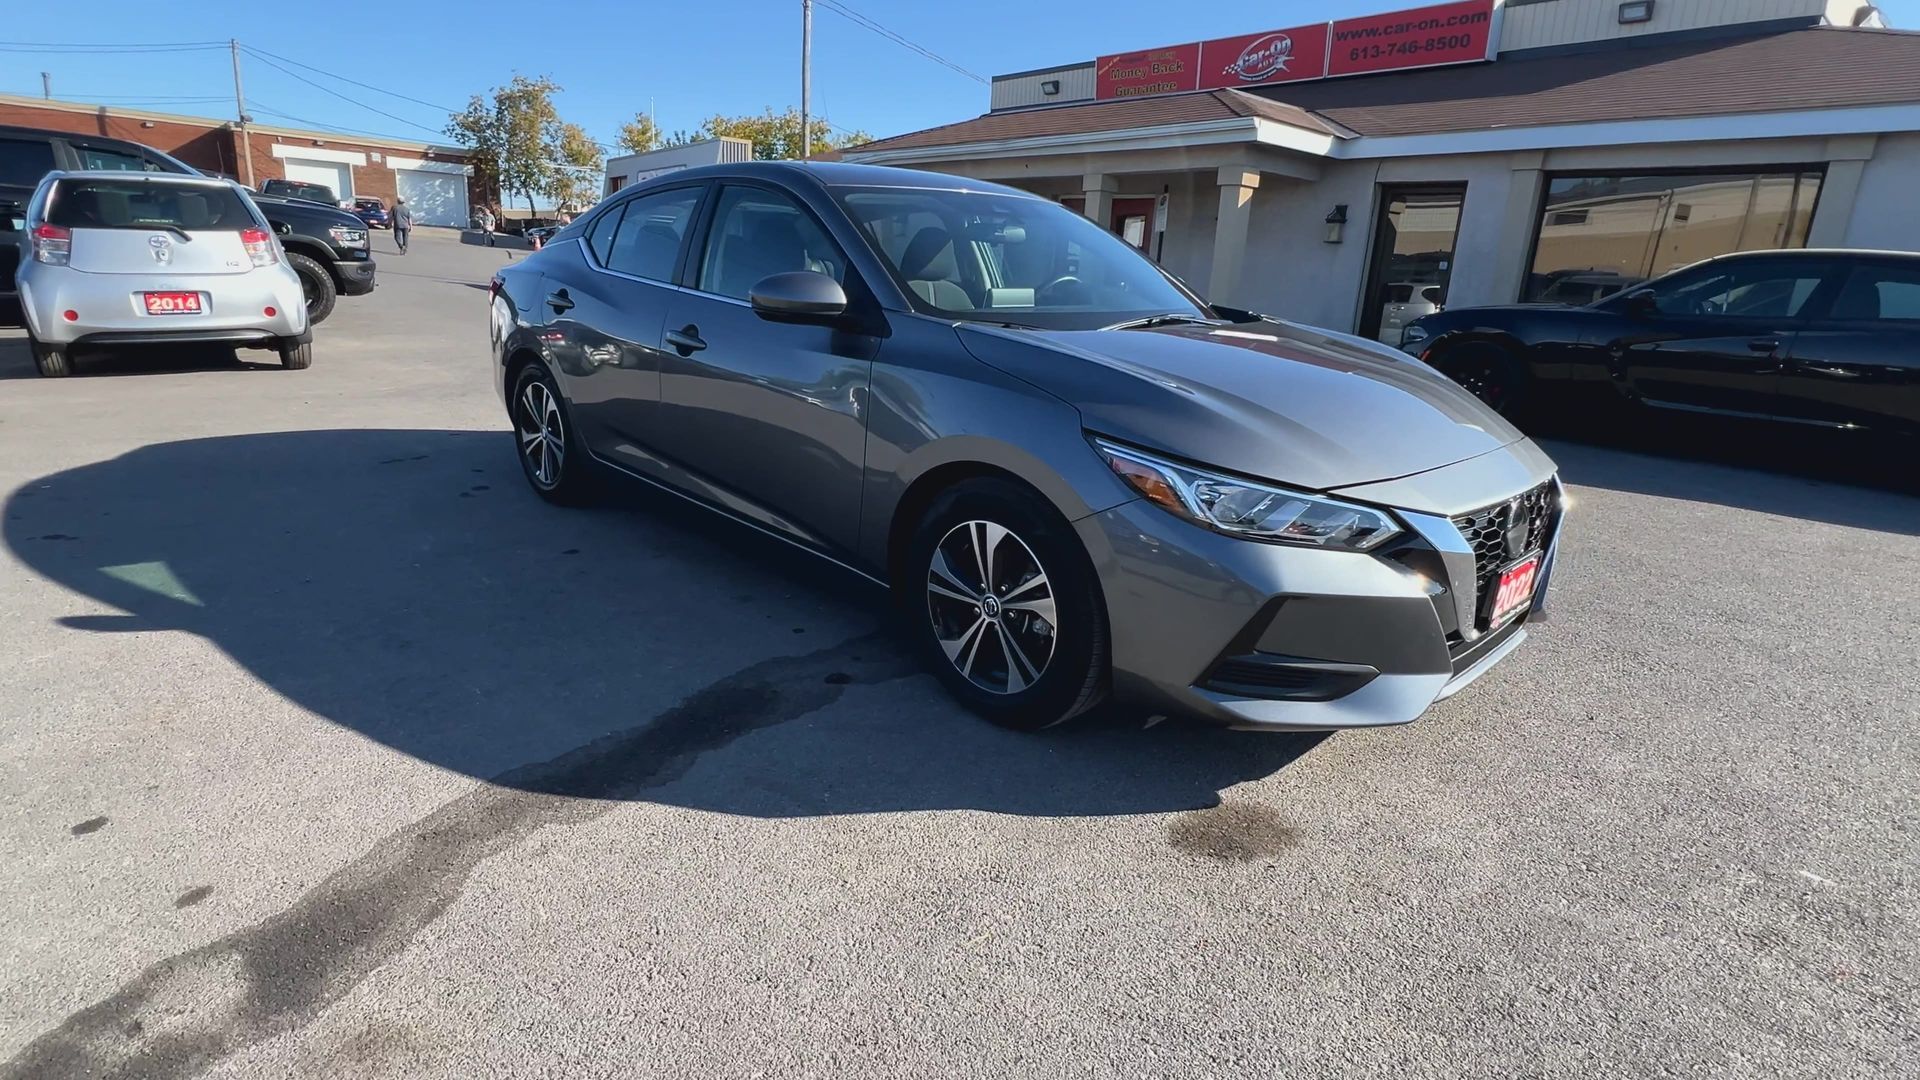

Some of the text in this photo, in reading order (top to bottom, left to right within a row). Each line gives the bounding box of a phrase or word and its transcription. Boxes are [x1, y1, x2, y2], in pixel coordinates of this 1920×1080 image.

[1336, 11, 1488, 41] www.car-on.com
[1350, 34, 1471, 61] 613-746-8500
[1111, 60, 1184, 80] Money Back
[1115, 81, 1177, 97] Guarantee
[149, 298, 197, 309] 2014
[1492, 567, 1535, 619] 2022
